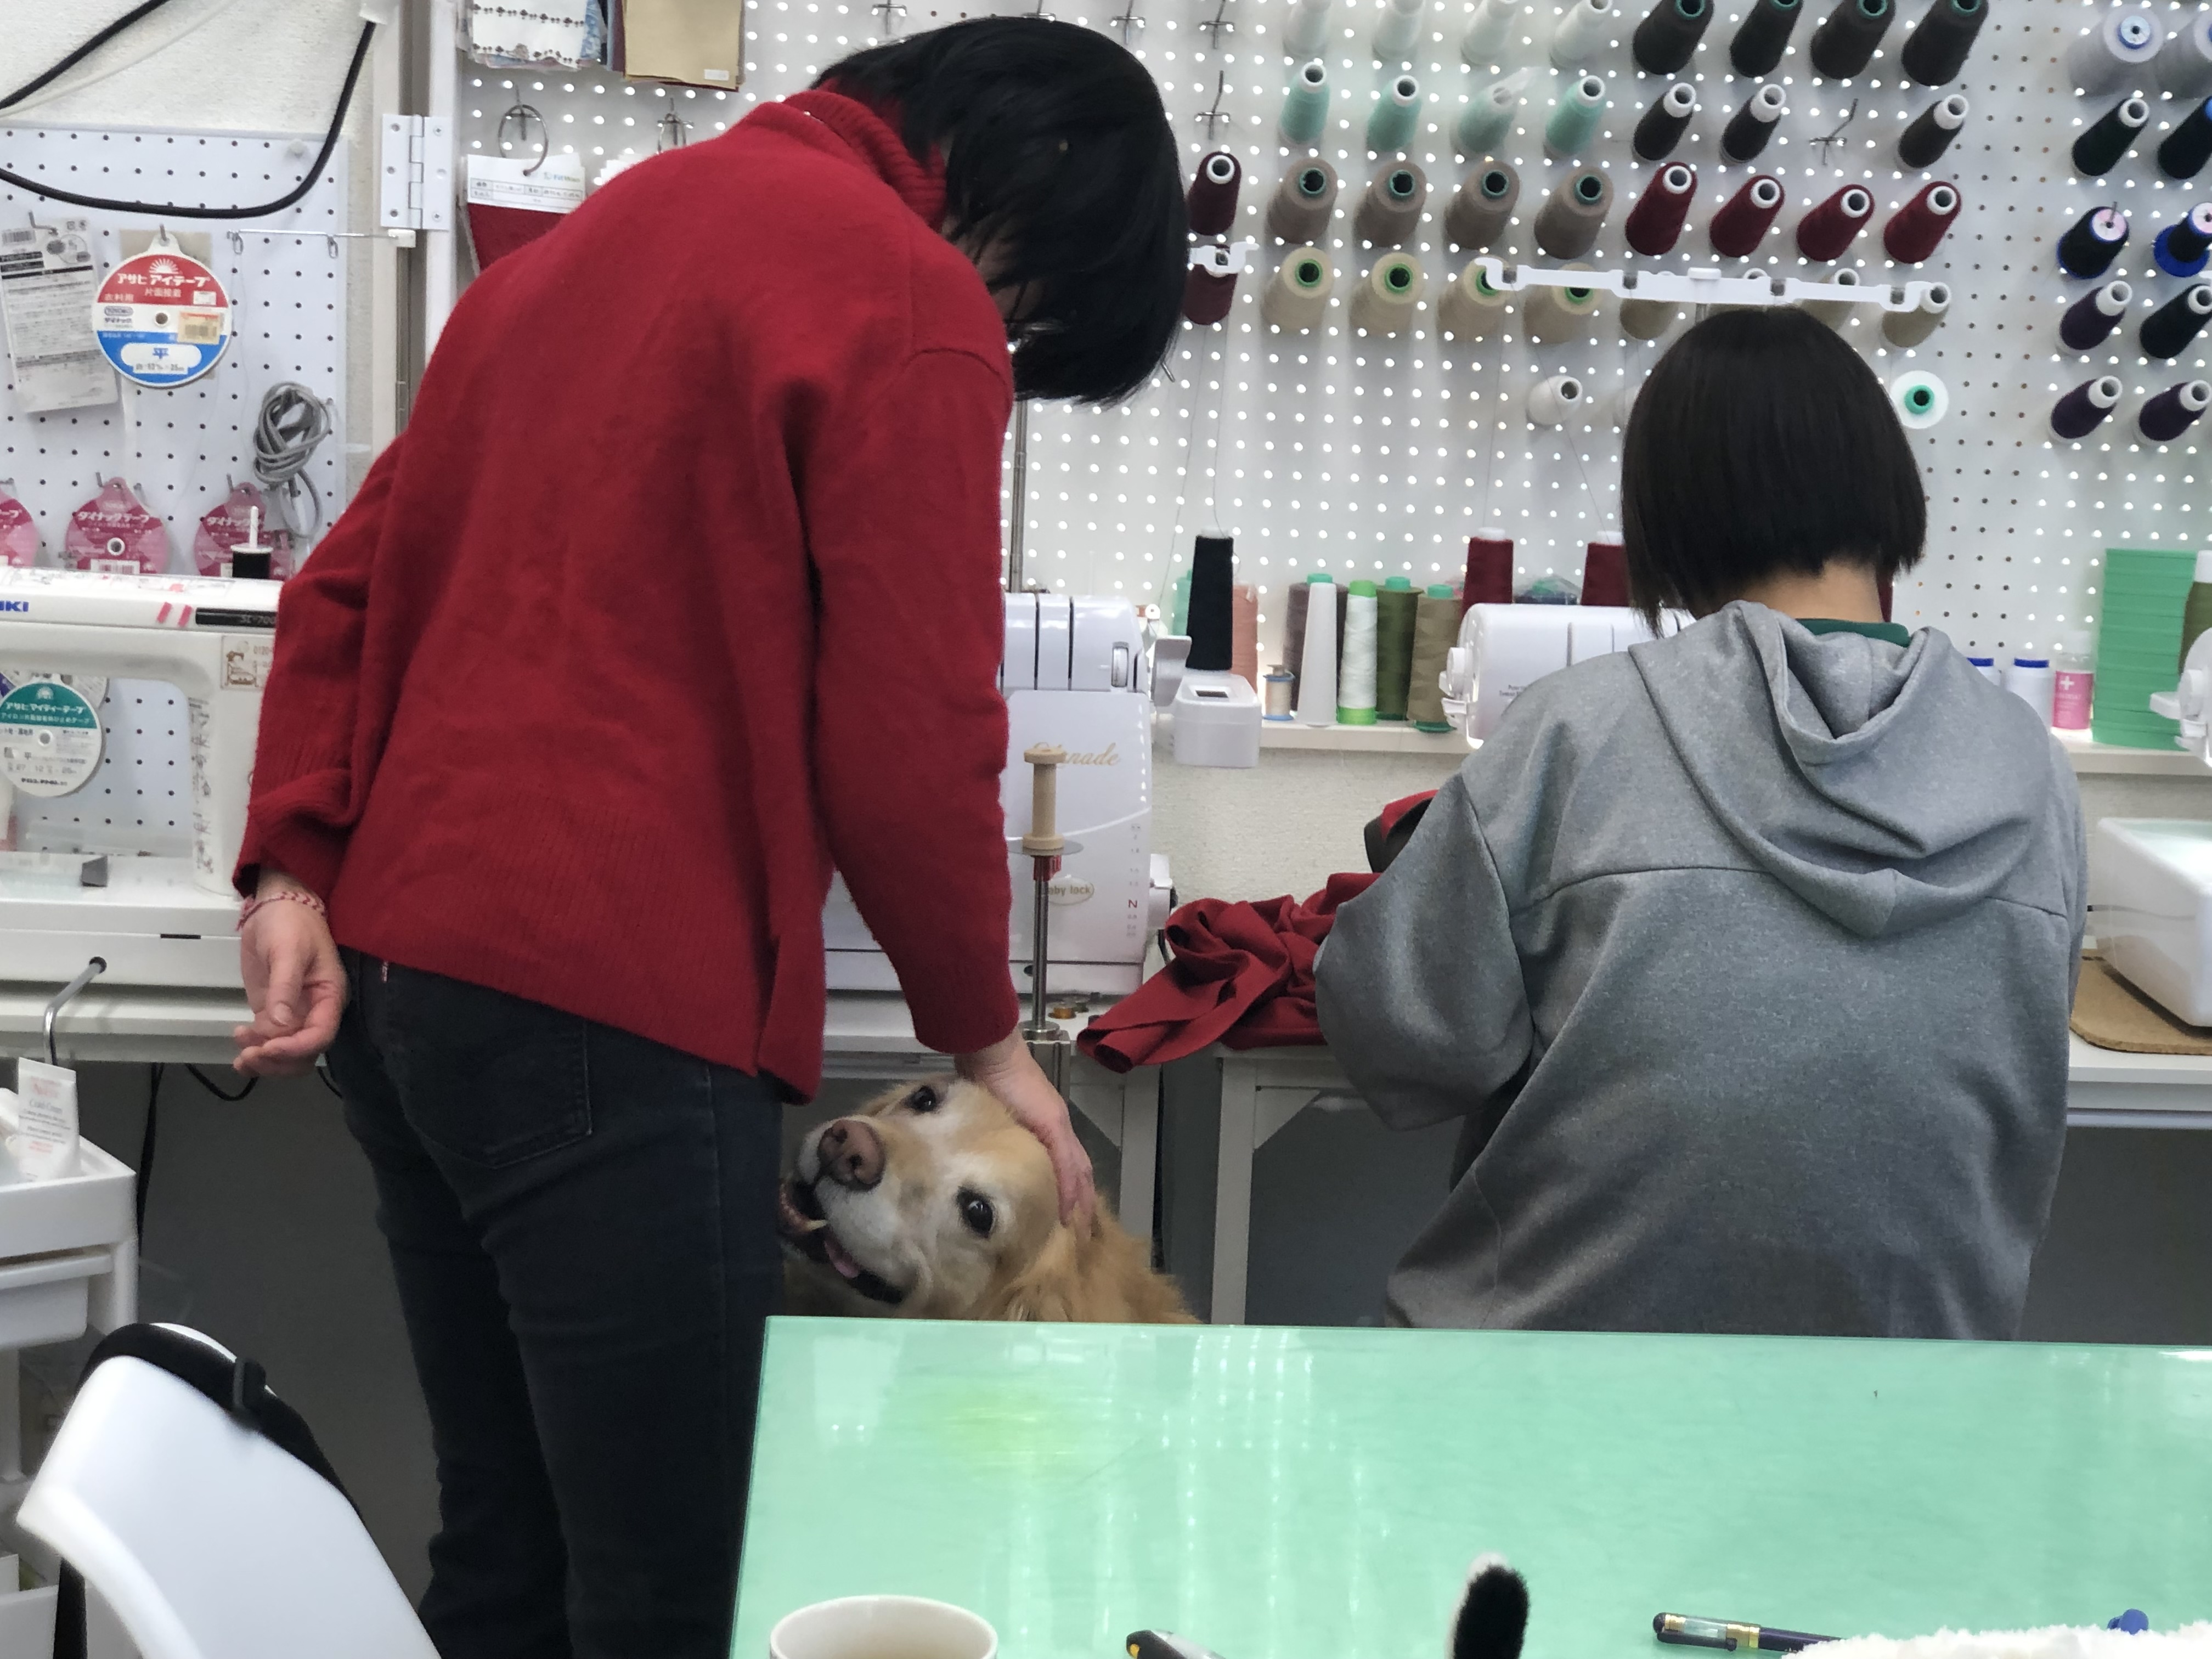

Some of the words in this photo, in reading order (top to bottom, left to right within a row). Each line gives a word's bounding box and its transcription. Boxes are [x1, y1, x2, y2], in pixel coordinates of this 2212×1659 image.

[1048, 885, 1066, 896] aby
[1070, 884, 1091, 894] lock
[1128, 899, 1138, 909] N
